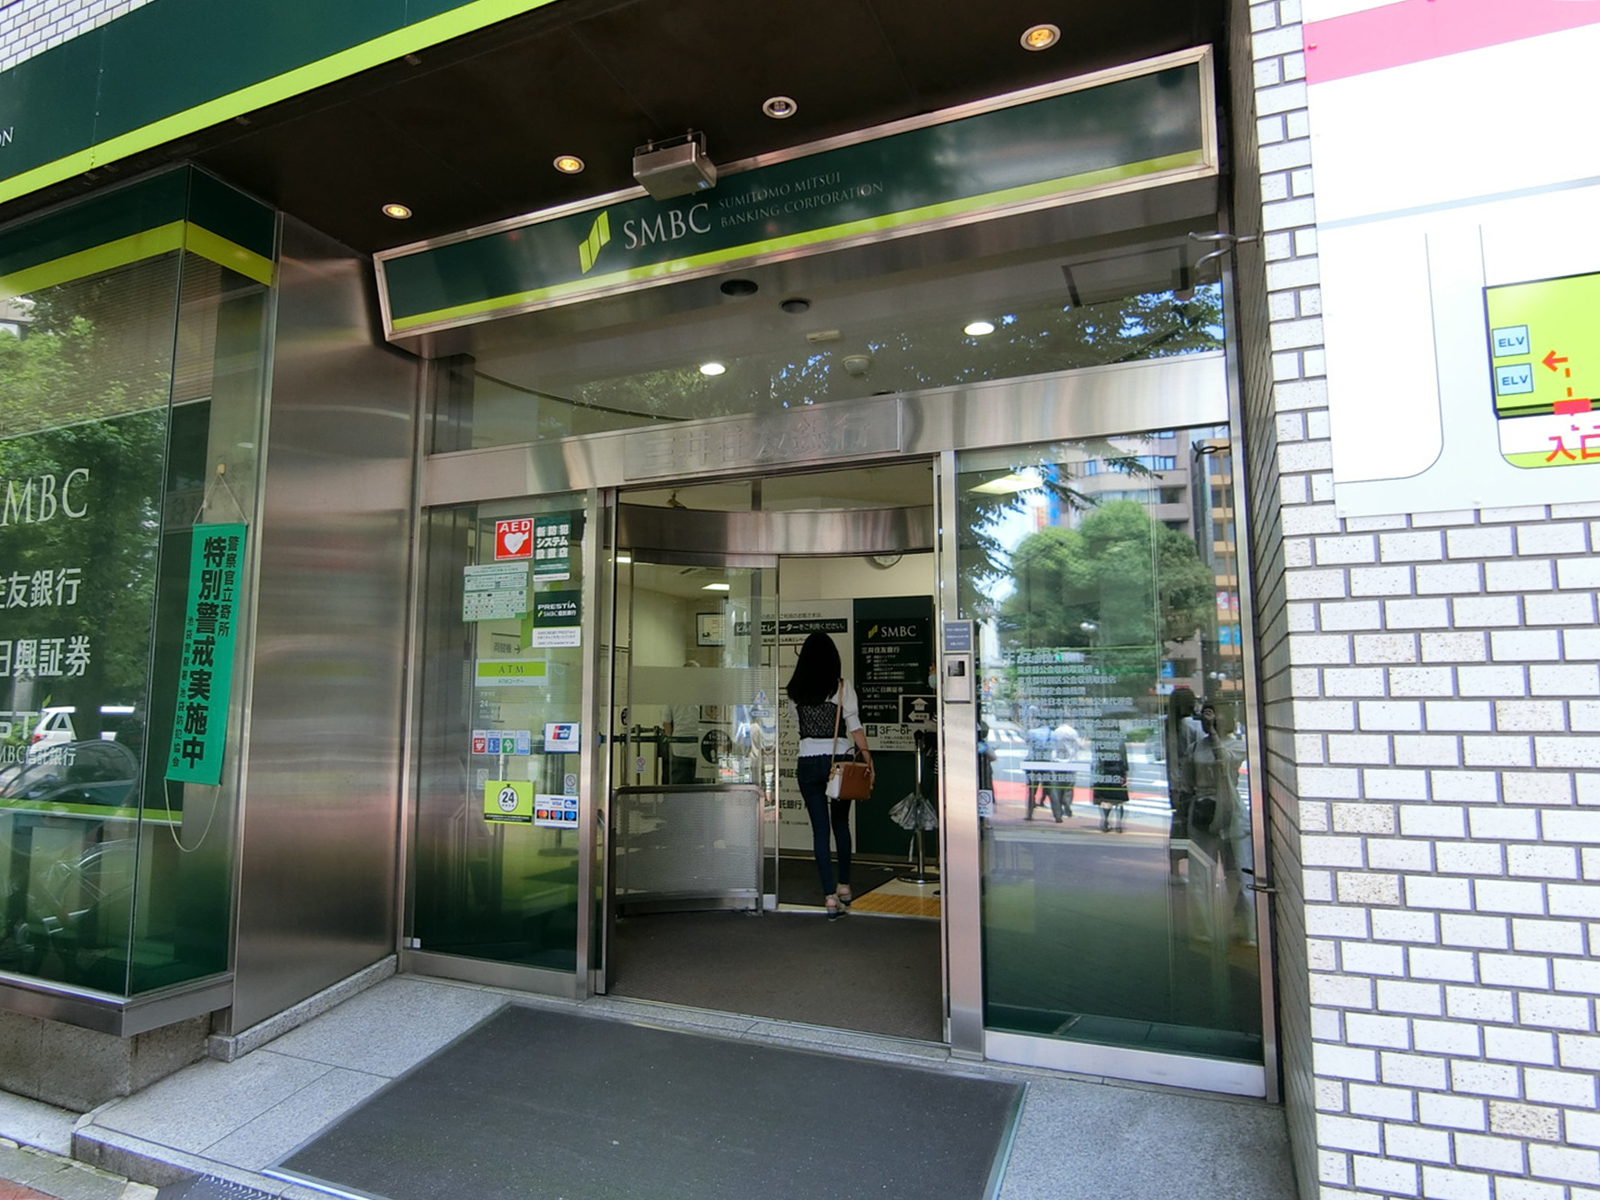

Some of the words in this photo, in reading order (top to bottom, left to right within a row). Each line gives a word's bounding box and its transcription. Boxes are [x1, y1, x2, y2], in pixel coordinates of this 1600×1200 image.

[623, 203, 711, 250] SMBC
[718, 183, 791, 210] SUMITOMO
[794, 171, 842, 192] MITSUI
[719, 204, 780, 229] BANKING
[784, 181, 884, 215] CORPORATION
[1498, 336, 1526, 348] ELV
[1501, 374, 1529, 386] ELV
[646, 415, 869, 470] 三井住友銀行
[1545, 434, 1600, 463] 入口
[499, 520, 531, 533] AED
[536, 525, 569, 537] 新防犯
[536, 537, 569, 548] システム
[217, 536, 241, 638] 警察官立寄所
[881, 625, 917, 638] SMBC
[0, 635, 91, 677] 日興証券
[181, 536, 228, 770] 特別警戒実施中
[861, 646, 901, 654] 三井住友銀行
[498, 664, 525, 674] ATM
[862, 686, 904, 694] SMBC日興証券
[502, 791, 515, 804] 24
